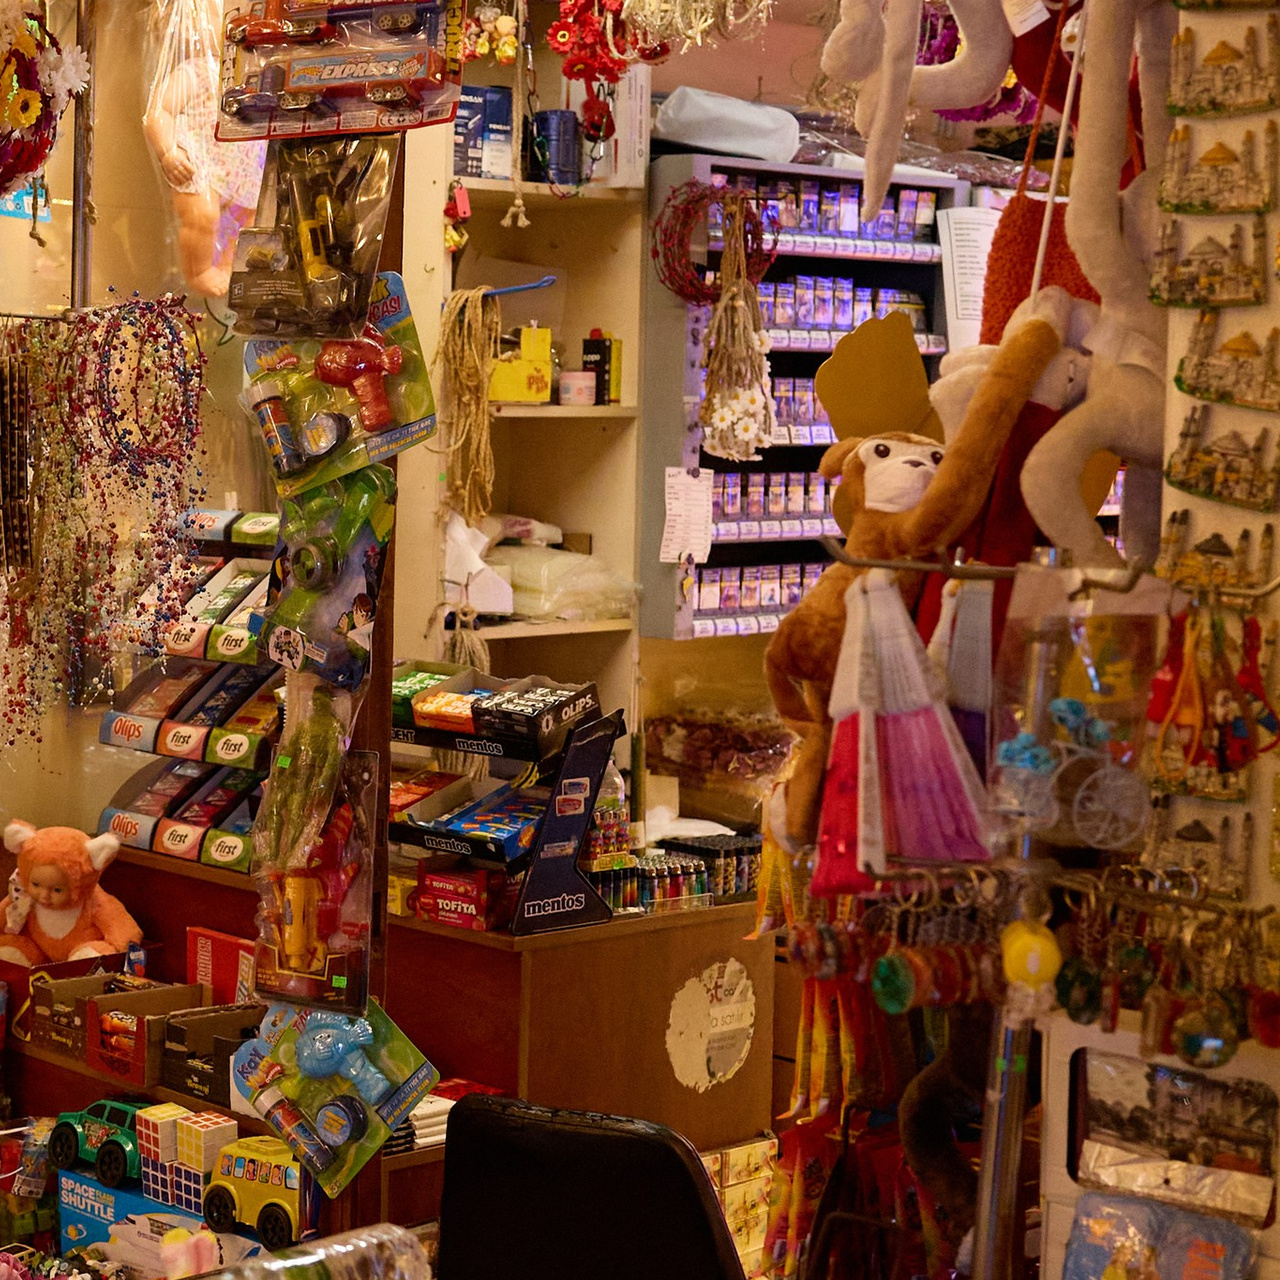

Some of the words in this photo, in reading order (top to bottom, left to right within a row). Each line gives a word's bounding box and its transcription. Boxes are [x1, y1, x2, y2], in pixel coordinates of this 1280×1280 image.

[320, 60, 399, 81] EXPRESS
[221, 633, 245, 650] first
[113, 716, 143, 741] Olips
[170, 729, 192, 745] first
[219, 736, 244, 753] first
[455, 737, 504, 757] mentos
[111, 814, 140, 839] Olips
[167, 827, 189, 844] first
[216, 839, 239, 855] first
[423, 834, 472, 856] mentos
[523, 892, 586, 919] mentos
[61, 1176, 96, 1200] SPACE
[61, 1190, 116, 1222] SHUTTLE
